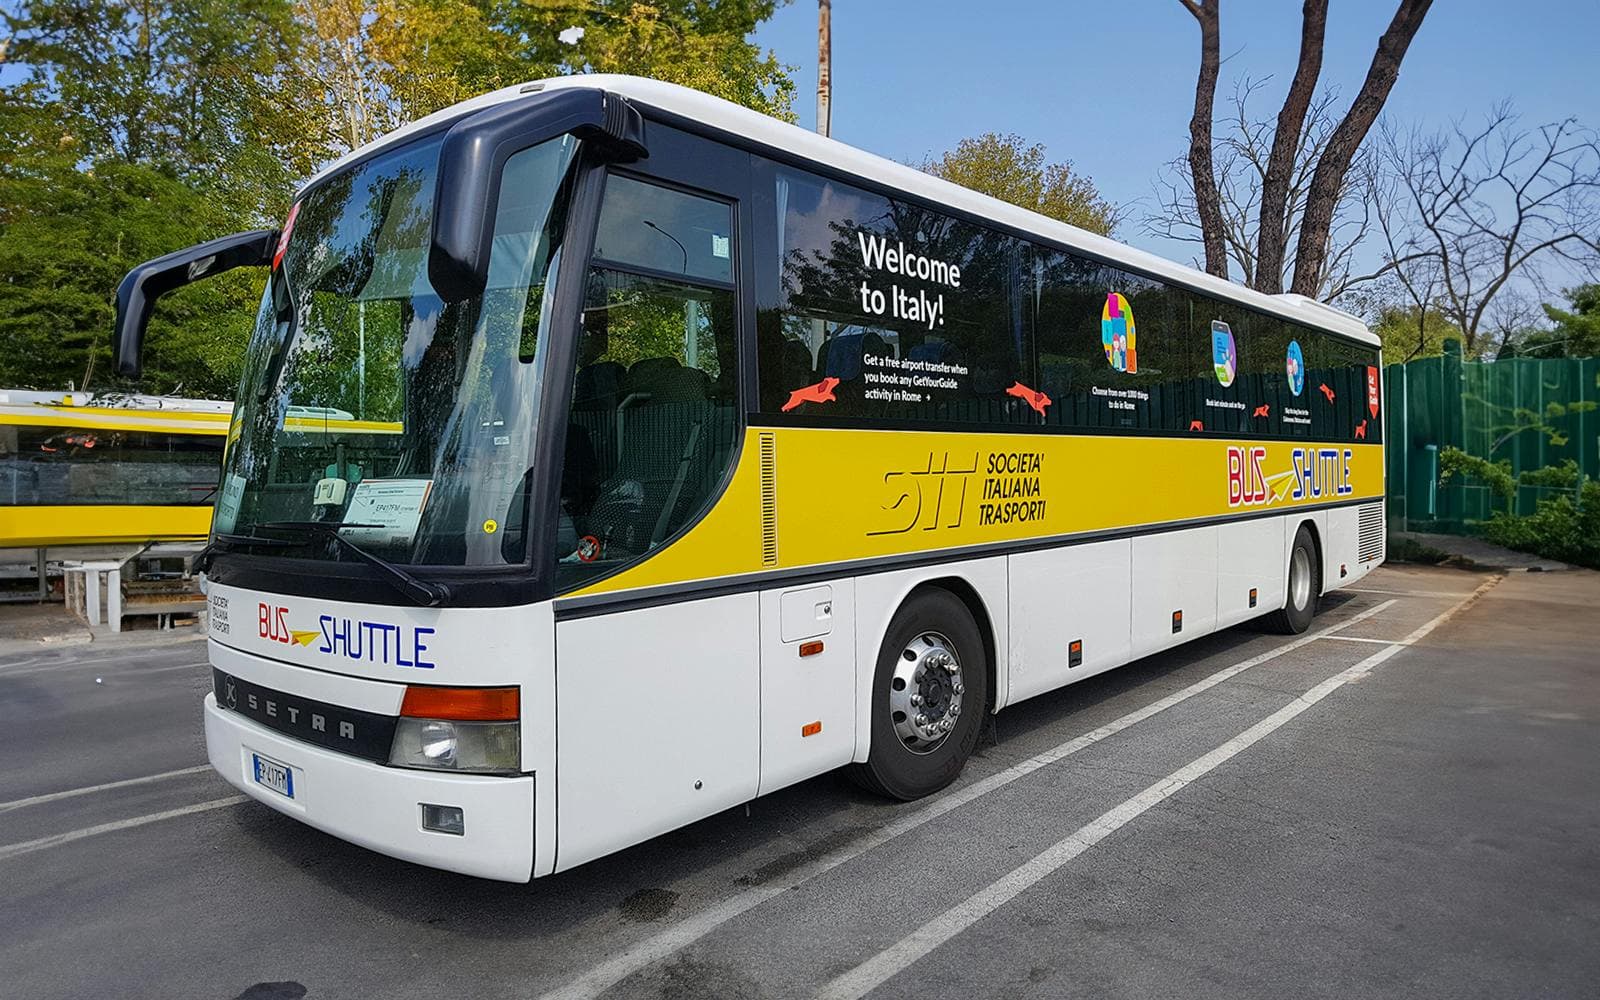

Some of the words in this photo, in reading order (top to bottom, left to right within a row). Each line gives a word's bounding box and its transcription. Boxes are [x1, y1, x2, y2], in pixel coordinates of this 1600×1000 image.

[858, 231, 961, 287] Welcome
[860, 281, 886, 315] to
[892, 284, 944, 330] Italy!
[863, 353, 878, 366] Get
[879, 358, 884, 367] a
[885, 356, 900, 368] free
[901, 358, 925, 371] airport
[925, 360, 951, 373] transfer
[951, 363, 968, 375] when
[864, 373, 879, 384] you
[880, 371, 898, 384] book
[899, 376, 912, 387] any
[912, 375, 958, 389] GetYourGuide
[864, 388, 893, 402] activity
[893, 389, 901, 401] in
[901, 390, 922, 402] Rome
[986, 452, 1045, 475] SOCIETA'
[982, 477, 1040, 500] ITALIANA
[1228, 448, 1266, 506] BUS
[1292, 448, 1352, 499] SHUTTLE
[979, 500, 1047, 526] TRASPORTI
[258, 602, 290, 644] BUS
[319, 614, 436, 670] SHUTTLE
[248, 693, 356, 740] SETRA
